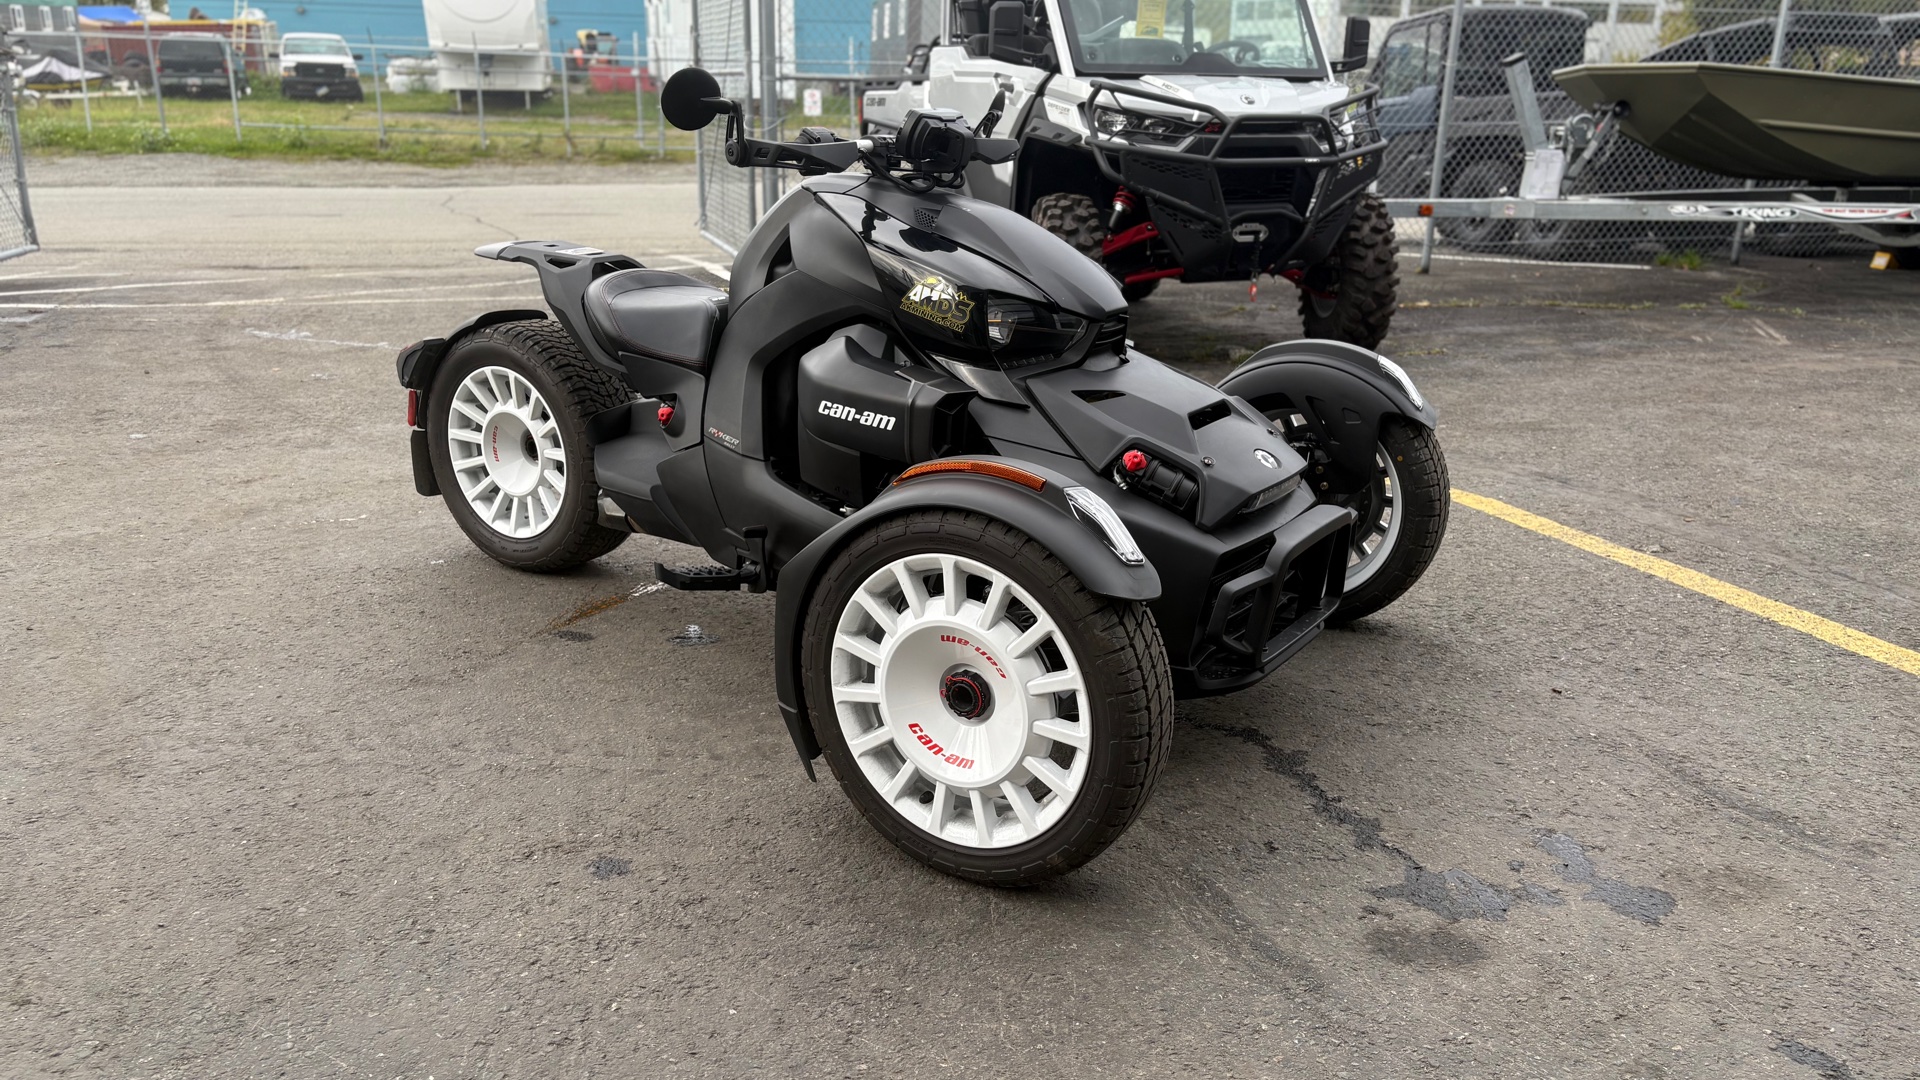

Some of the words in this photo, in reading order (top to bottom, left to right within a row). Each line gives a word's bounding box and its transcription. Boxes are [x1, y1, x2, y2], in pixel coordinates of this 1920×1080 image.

[1047, 102, 1070, 113] DEFENDER
[900, 302, 965, 333] AKMINING.COM
[901, 282, 975, 325] AMDS
[818, 400, 897, 431] can-am
[940, 634, 1007, 679] can-am
[908, 722, 975, 770] can-am
